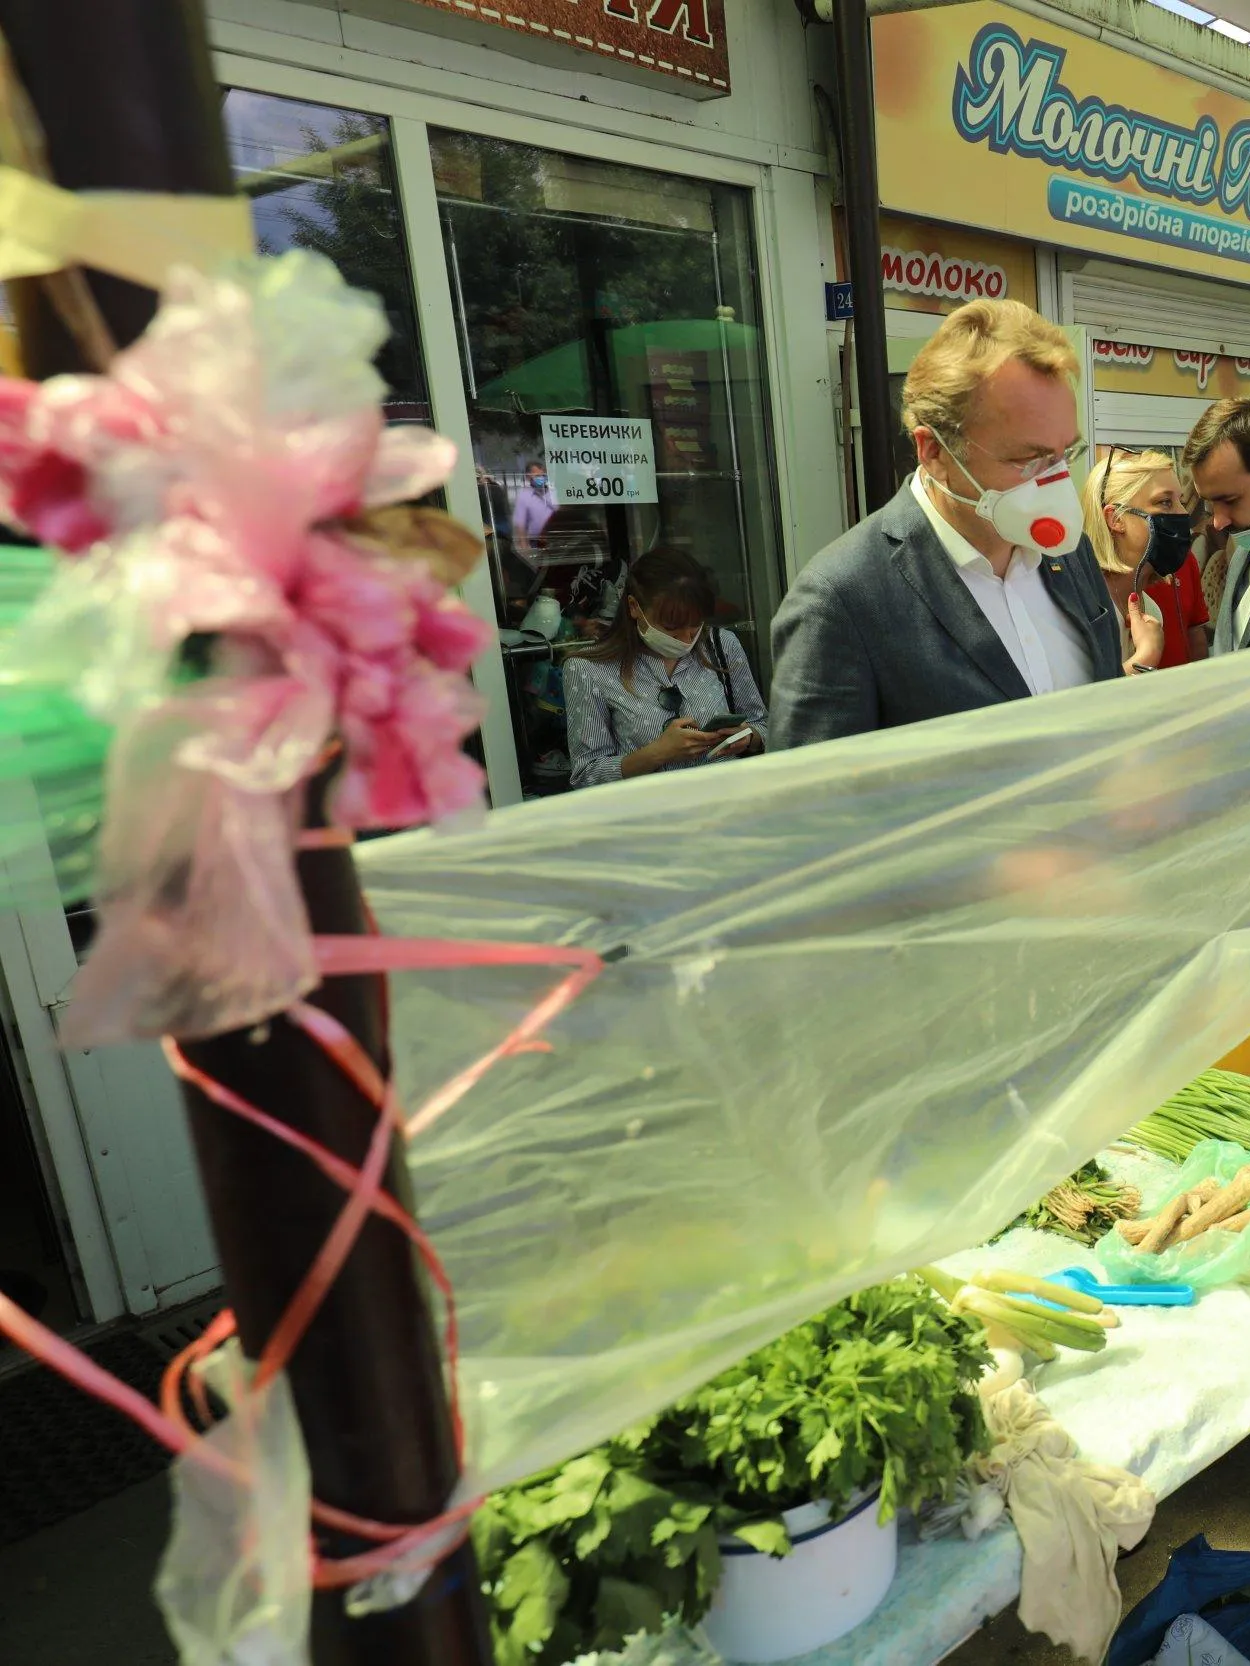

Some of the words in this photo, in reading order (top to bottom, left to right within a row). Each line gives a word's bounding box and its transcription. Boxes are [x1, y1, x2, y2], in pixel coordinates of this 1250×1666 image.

[960, 34, 1217, 199] Молочні
[1065, 190, 1184, 237] роздрібна
[837, 292, 853, 309] 24
[549, 423, 642, 440] ЧЕРЕВИЧКИ
[549, 450, 607, 464] ЖІНОЧІ
[610, 453, 649, 465] ШКІРА
[566, 486, 584, 498] від
[586, 477, 624, 497] 800
